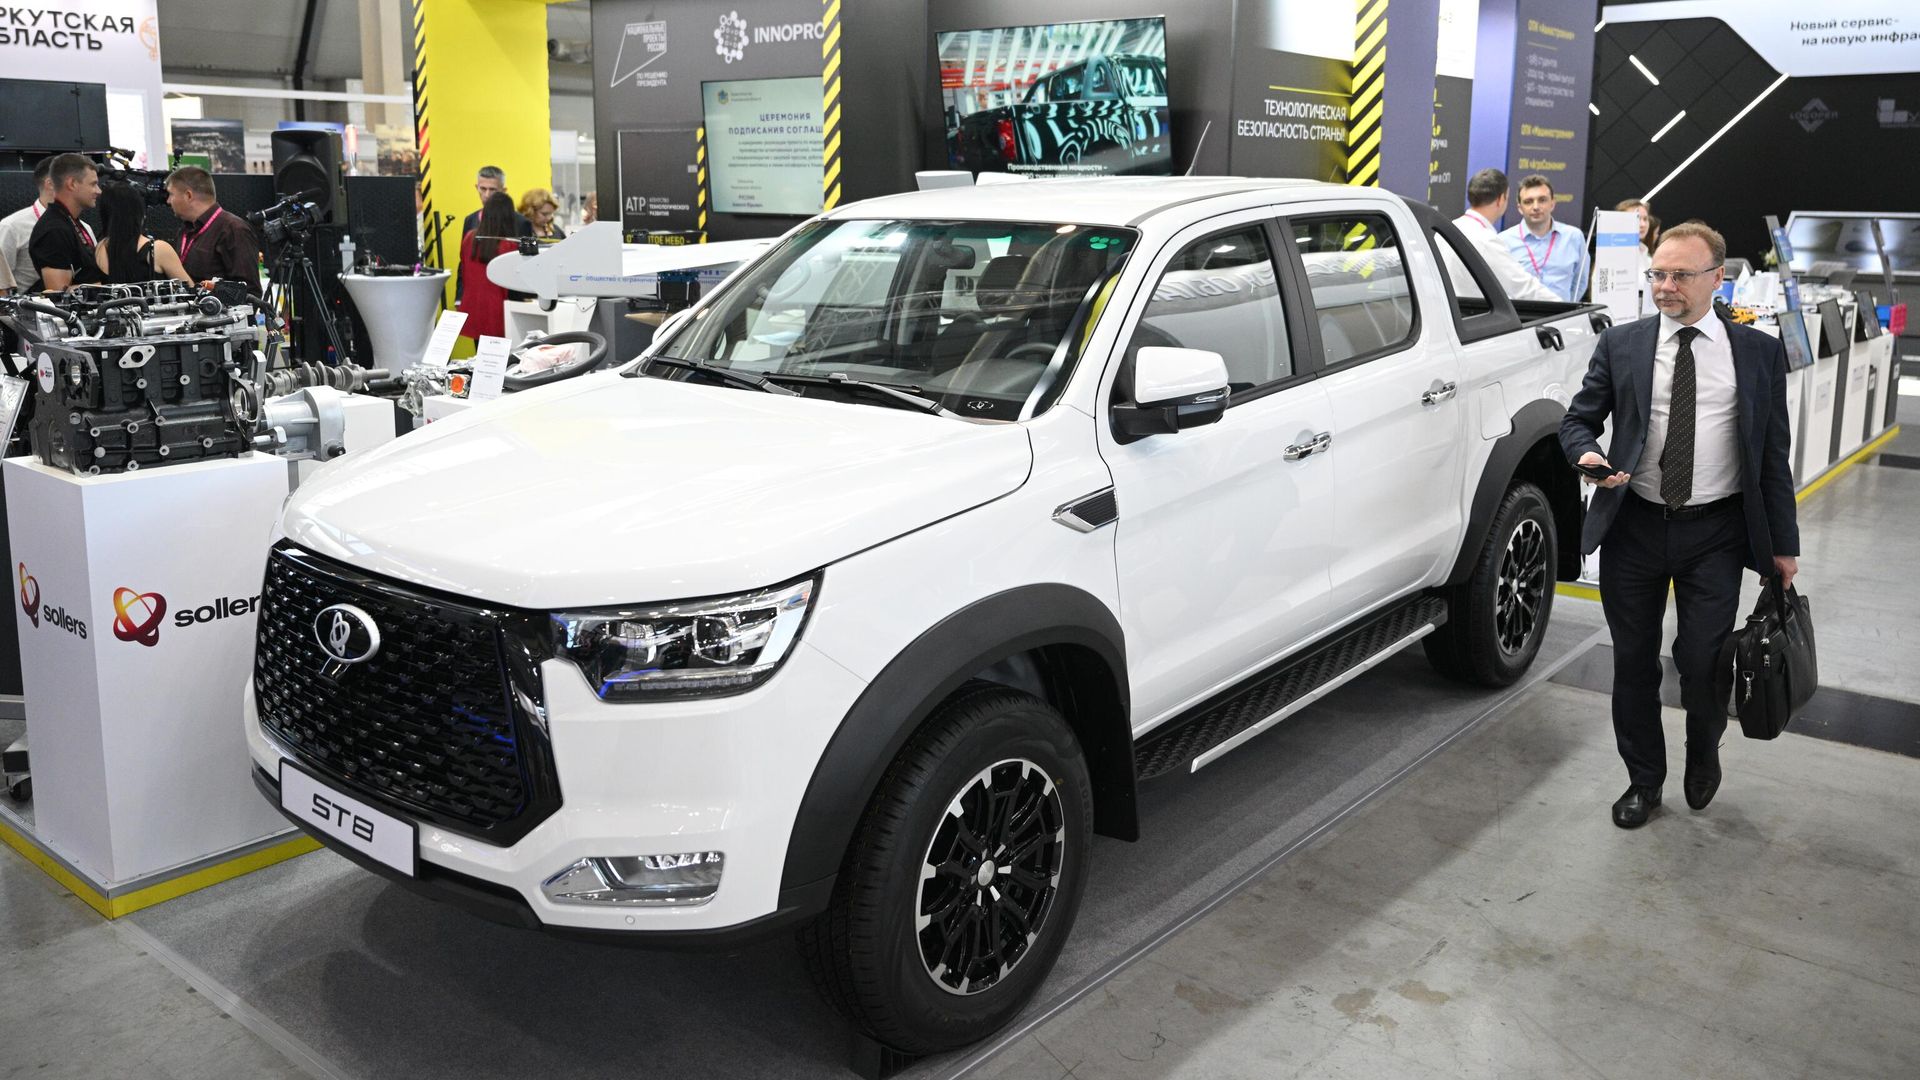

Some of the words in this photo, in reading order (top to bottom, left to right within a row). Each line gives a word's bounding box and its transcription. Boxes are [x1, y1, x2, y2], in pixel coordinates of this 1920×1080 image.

[1790, 19, 1837, 31] Новый
[1802, 38, 1818, 46] на
[1822, 34, 1867, 46] новую
[1264, 99, 1347, 120] ТЕХНОЛОГИЧЕСКАЯ
[760, 112, 811, 122] ЦЕРЕМОНИЯ
[729, 126, 784, 135] ПОДПИСАНИЯ
[1237, 119, 1309, 140] БЕЗОПАСНОСТЬ
[625, 196, 646, 212] АТР
[665, 235, 685, 245] НЕБО
[43, 603, 87, 640] sollers
[311, 793, 374, 843] ST8
